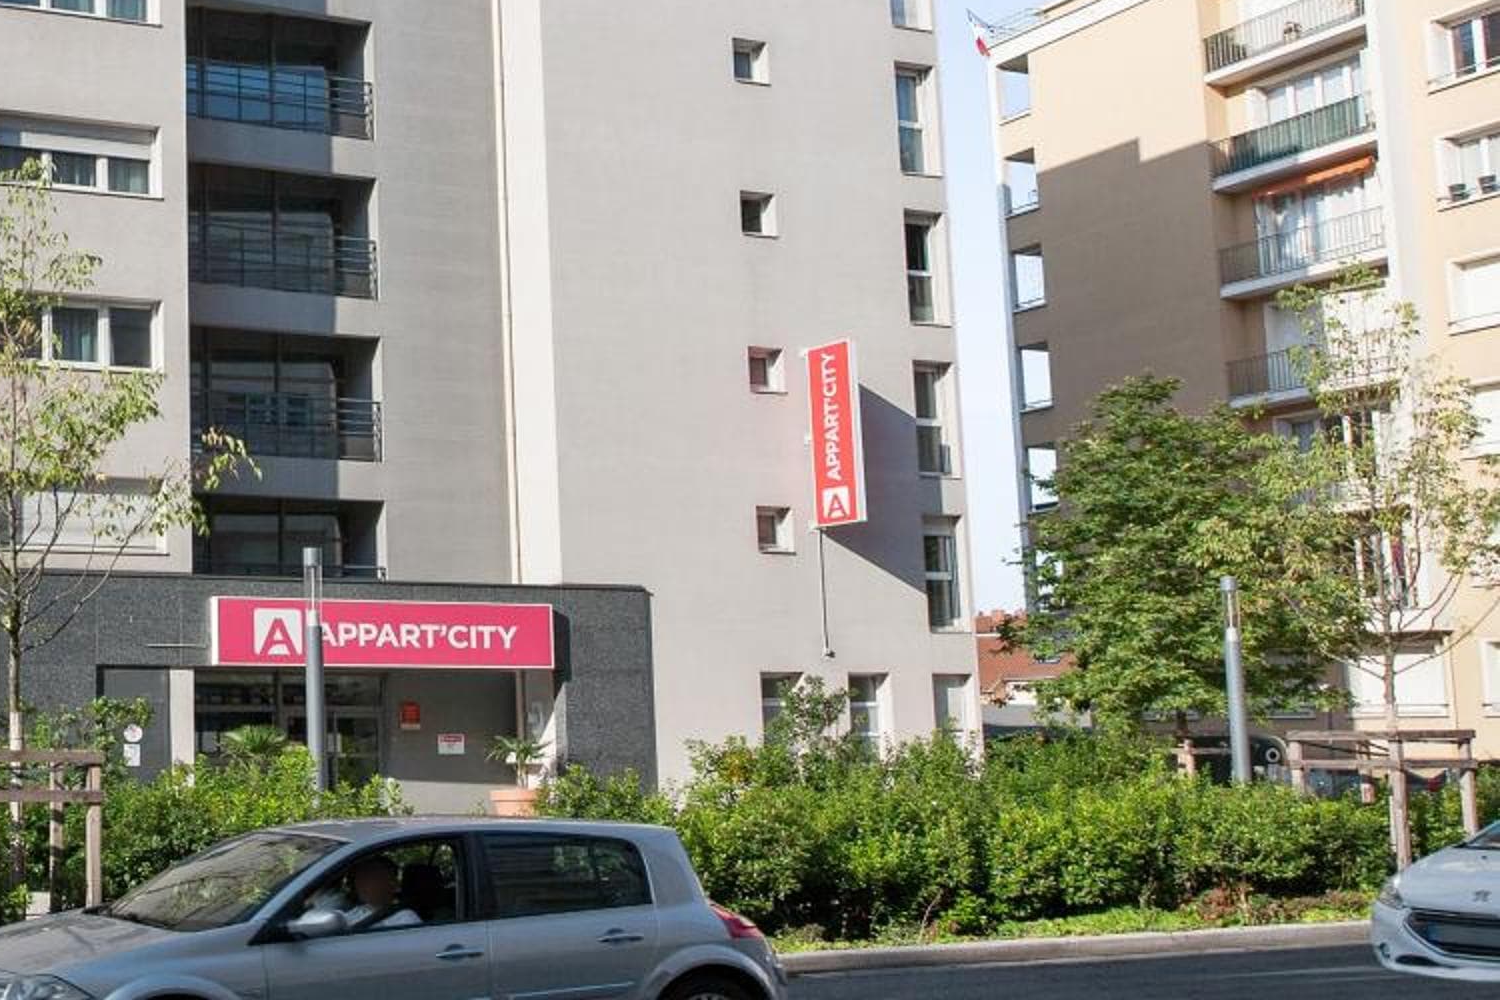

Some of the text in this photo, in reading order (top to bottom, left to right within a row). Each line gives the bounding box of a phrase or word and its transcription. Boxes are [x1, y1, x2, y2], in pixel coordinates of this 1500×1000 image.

[820, 352, 842, 482] APPART'CITY
[257, 612, 517, 656] A APPART'CITY
